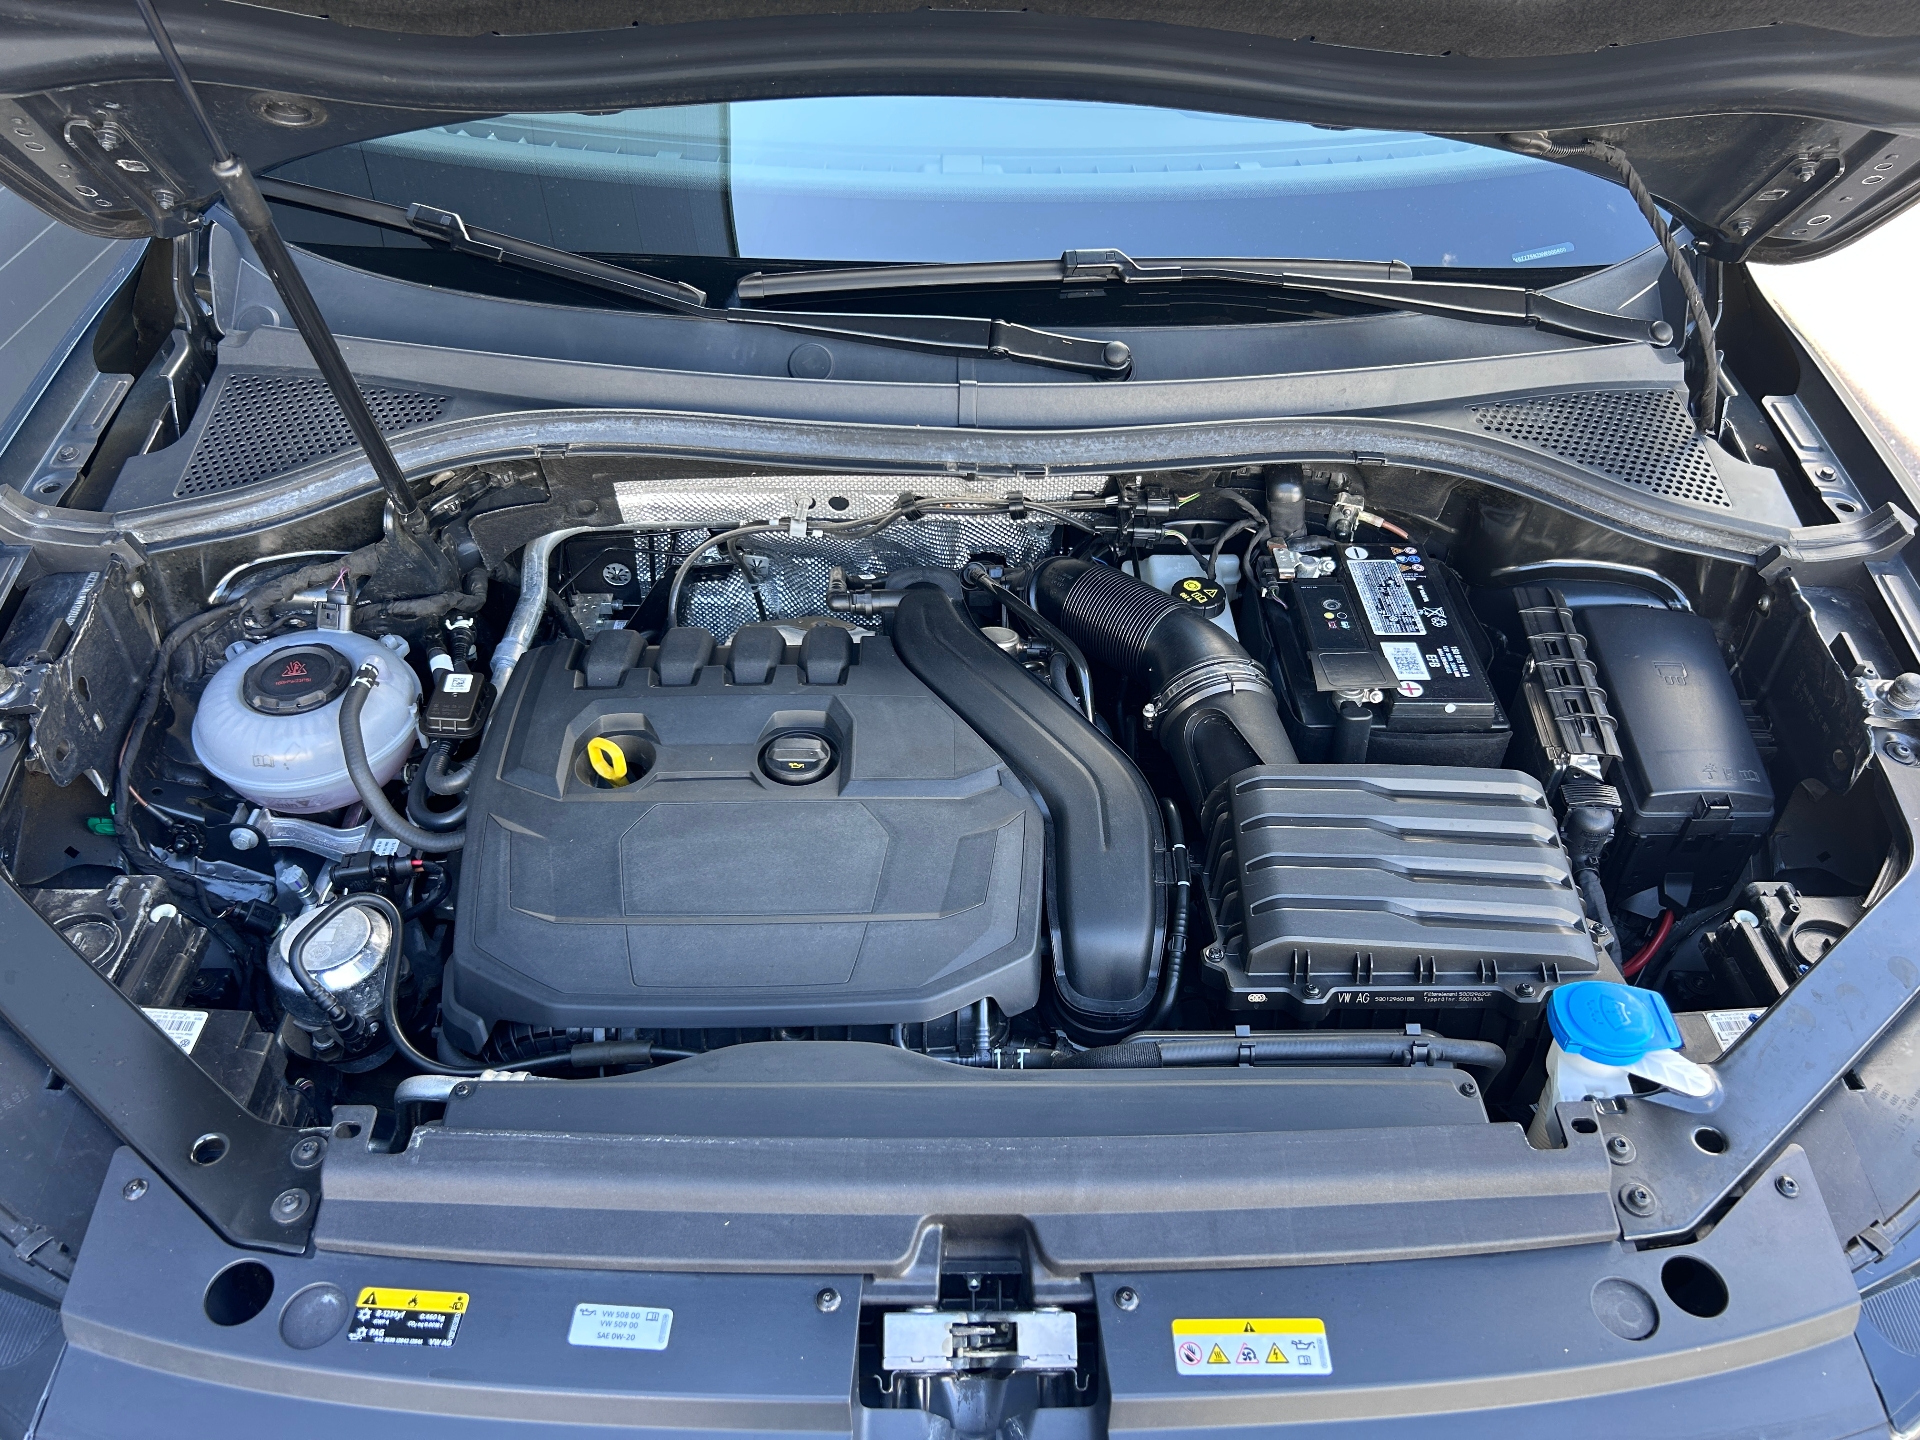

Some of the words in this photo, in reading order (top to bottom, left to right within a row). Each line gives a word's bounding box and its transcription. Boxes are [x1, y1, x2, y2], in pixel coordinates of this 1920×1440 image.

[1425, 654, 1441, 668] EFB
[1338, 993, 1352, 1003] VW
[1356, 993, 1370, 1004] AG
[602, 1310, 614, 1318] VW
[616, 1311, 630, 1319] 508
[630, 1312, 641, 1320] 00
[613, 1320, 627, 1328] 509
[628, 1321, 639, 1329] 00
[368, 1329, 386, 1337] PAG
[597, 1331, 610, 1339] SAE
[611, 1332, 636, 1341] 0W-20
[428, 1338, 441, 1346] VW
[441, 1339, 452, 1347] AG
